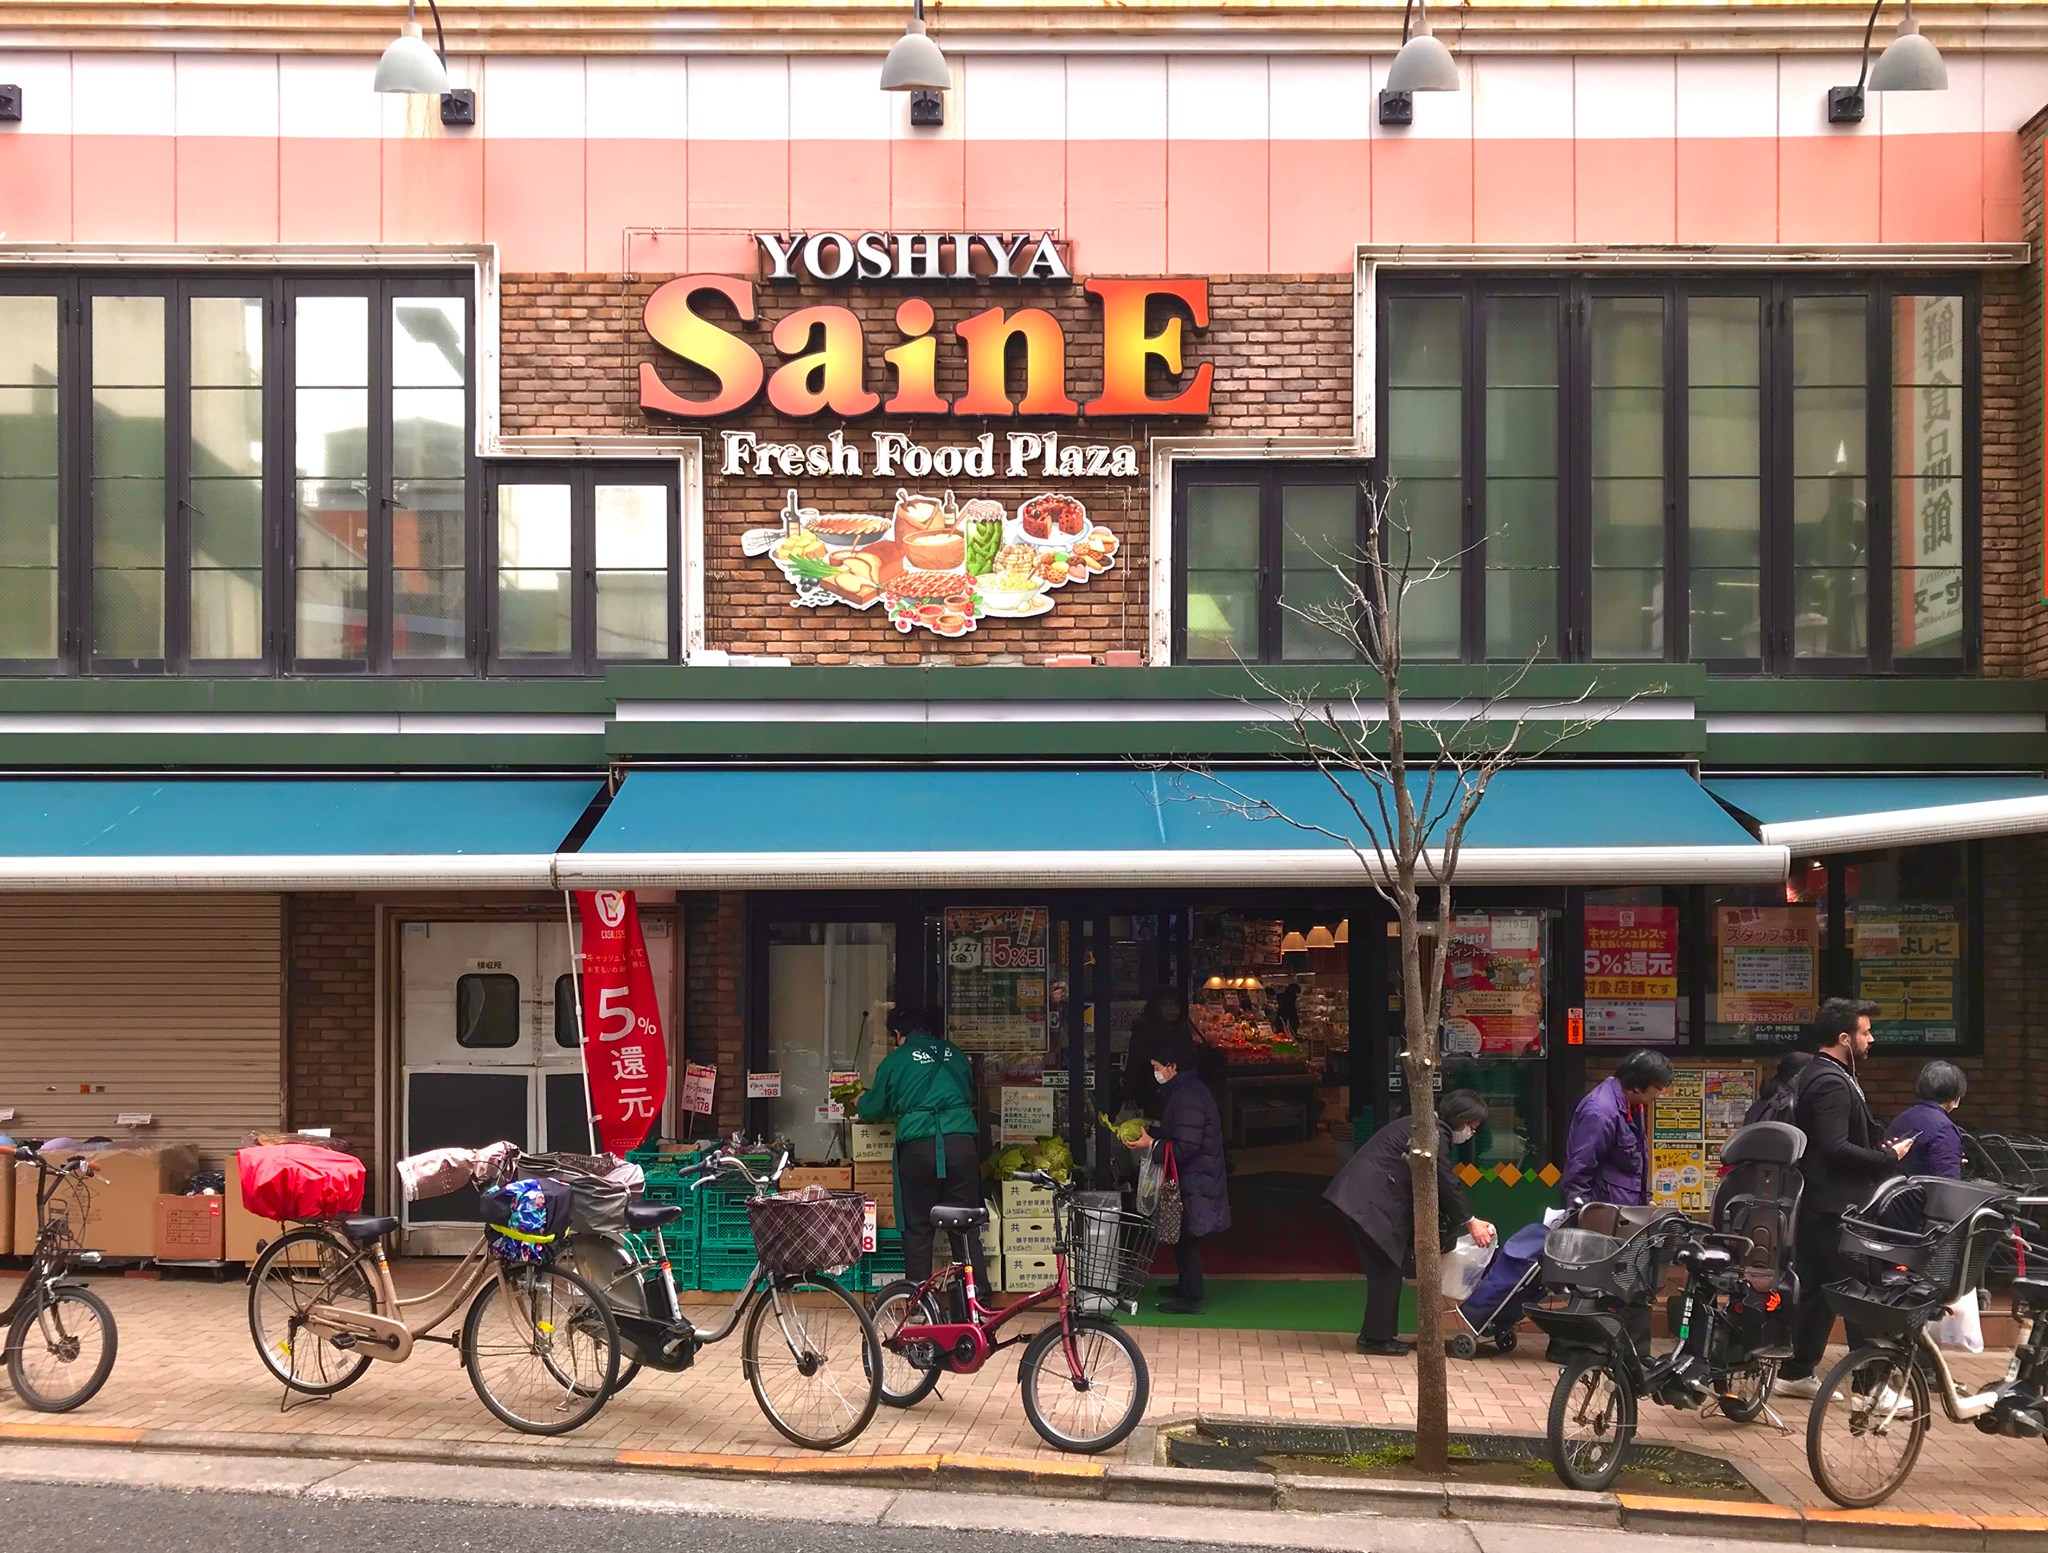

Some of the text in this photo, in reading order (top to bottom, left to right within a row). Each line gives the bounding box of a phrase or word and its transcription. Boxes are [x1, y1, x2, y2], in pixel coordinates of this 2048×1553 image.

[755, 231, 1073, 282] YOSHIYA
[638, 272, 1214, 420] SainE
[720, 430, 1139, 477] Fresh Food Plaza
[1588, 927, 1667, 940] キャッシュレスで
[1726, 927, 1811, 943] スタッフ募集
[951, 943, 978, 952] 3/27
[1590, 940, 1665, 949] お支払いのお客様に
[993, 936, 1045, 967] 5%引
[587, 960, 646, 974] お支払いのお様に
[1584, 950, 1673, 976] 5%還元
[1584, 979, 1671, 995] 対象店舗です
[764, 1088, 779, 1096] 198
[697, 1101, 710, 1112] 178
[860, 1129, 870, 1139] 共
[1655, 1150, 1692, 1162] 電子レシート
[1656, 1159, 1689, 1169] はじめました
[1010, 1186, 1020, 1196] 共
[1010, 1222, 1020, 1232] 共
[1013, 1260, 1023, 1270] 共
